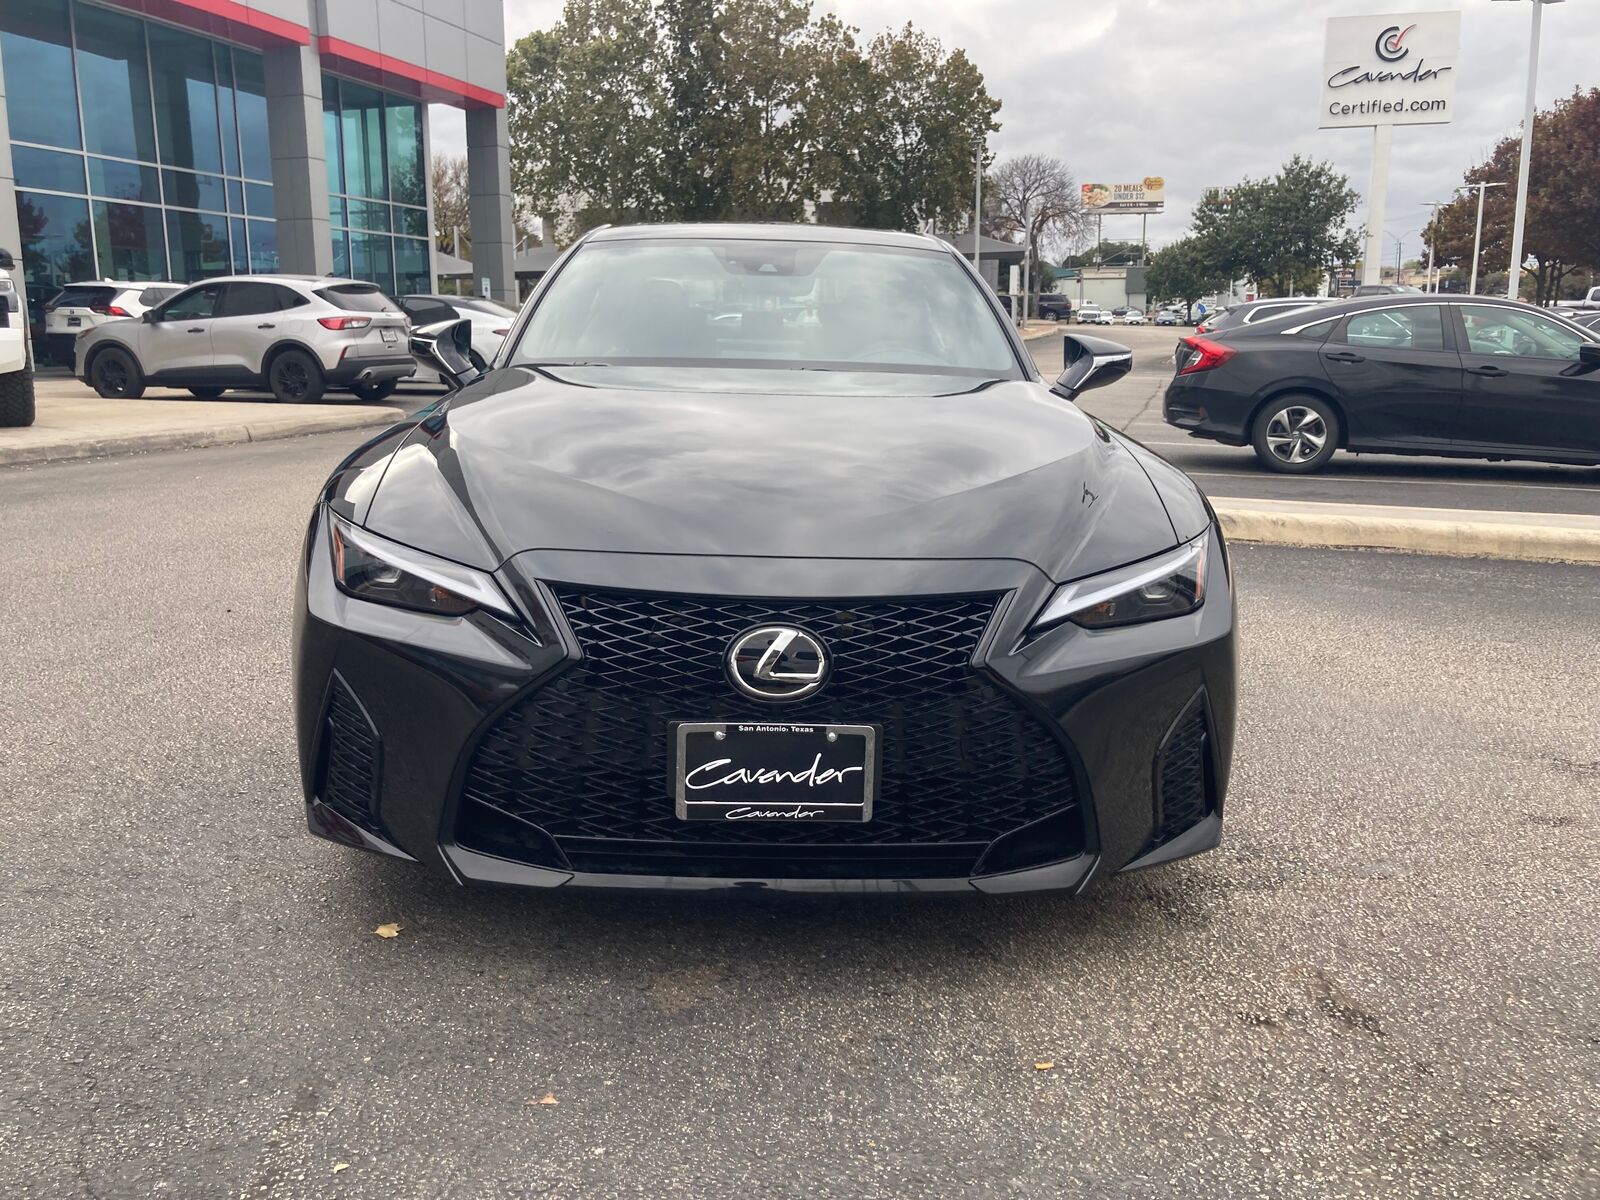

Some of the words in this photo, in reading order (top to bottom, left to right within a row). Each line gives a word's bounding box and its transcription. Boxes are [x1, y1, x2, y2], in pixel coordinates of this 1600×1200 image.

[1328, 59, 1452, 88] Cavender
[1329, 99, 1446, 116] Certified.com
[1114, 184, 1122, 193] 20
[1123, 184, 1143, 193] MEALS
[1114, 192, 1134, 201] UNDER
[685, 752, 863, 790] Cavender
[725, 806, 824, 820] Cavender
